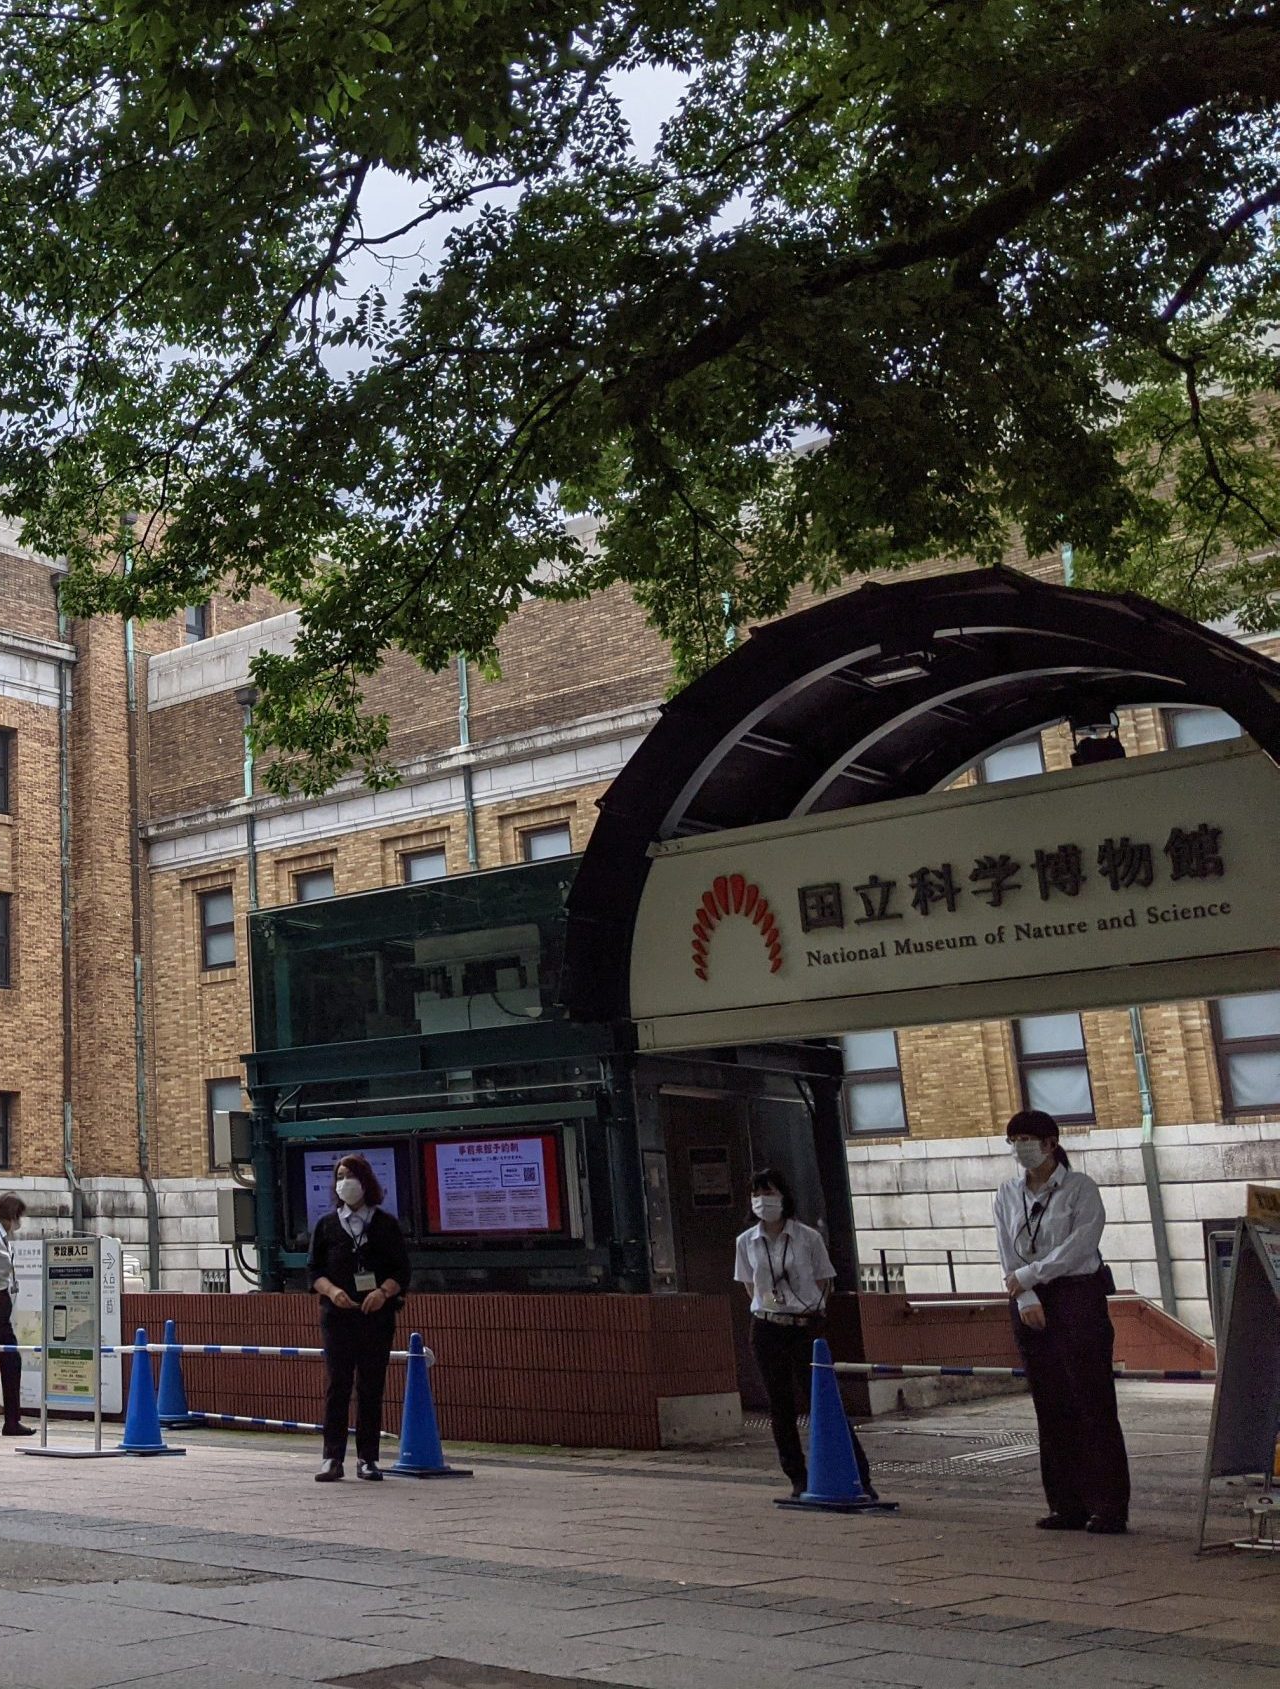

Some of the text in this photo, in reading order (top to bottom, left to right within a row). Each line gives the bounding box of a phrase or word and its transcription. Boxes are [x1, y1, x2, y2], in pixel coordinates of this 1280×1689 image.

[798, 823, 1224, 934] 国立科学博物館
[806, 901, 1232, 967] National Museum of Nature and Science
[53, 1246, 88, 1257] 常設展入口
